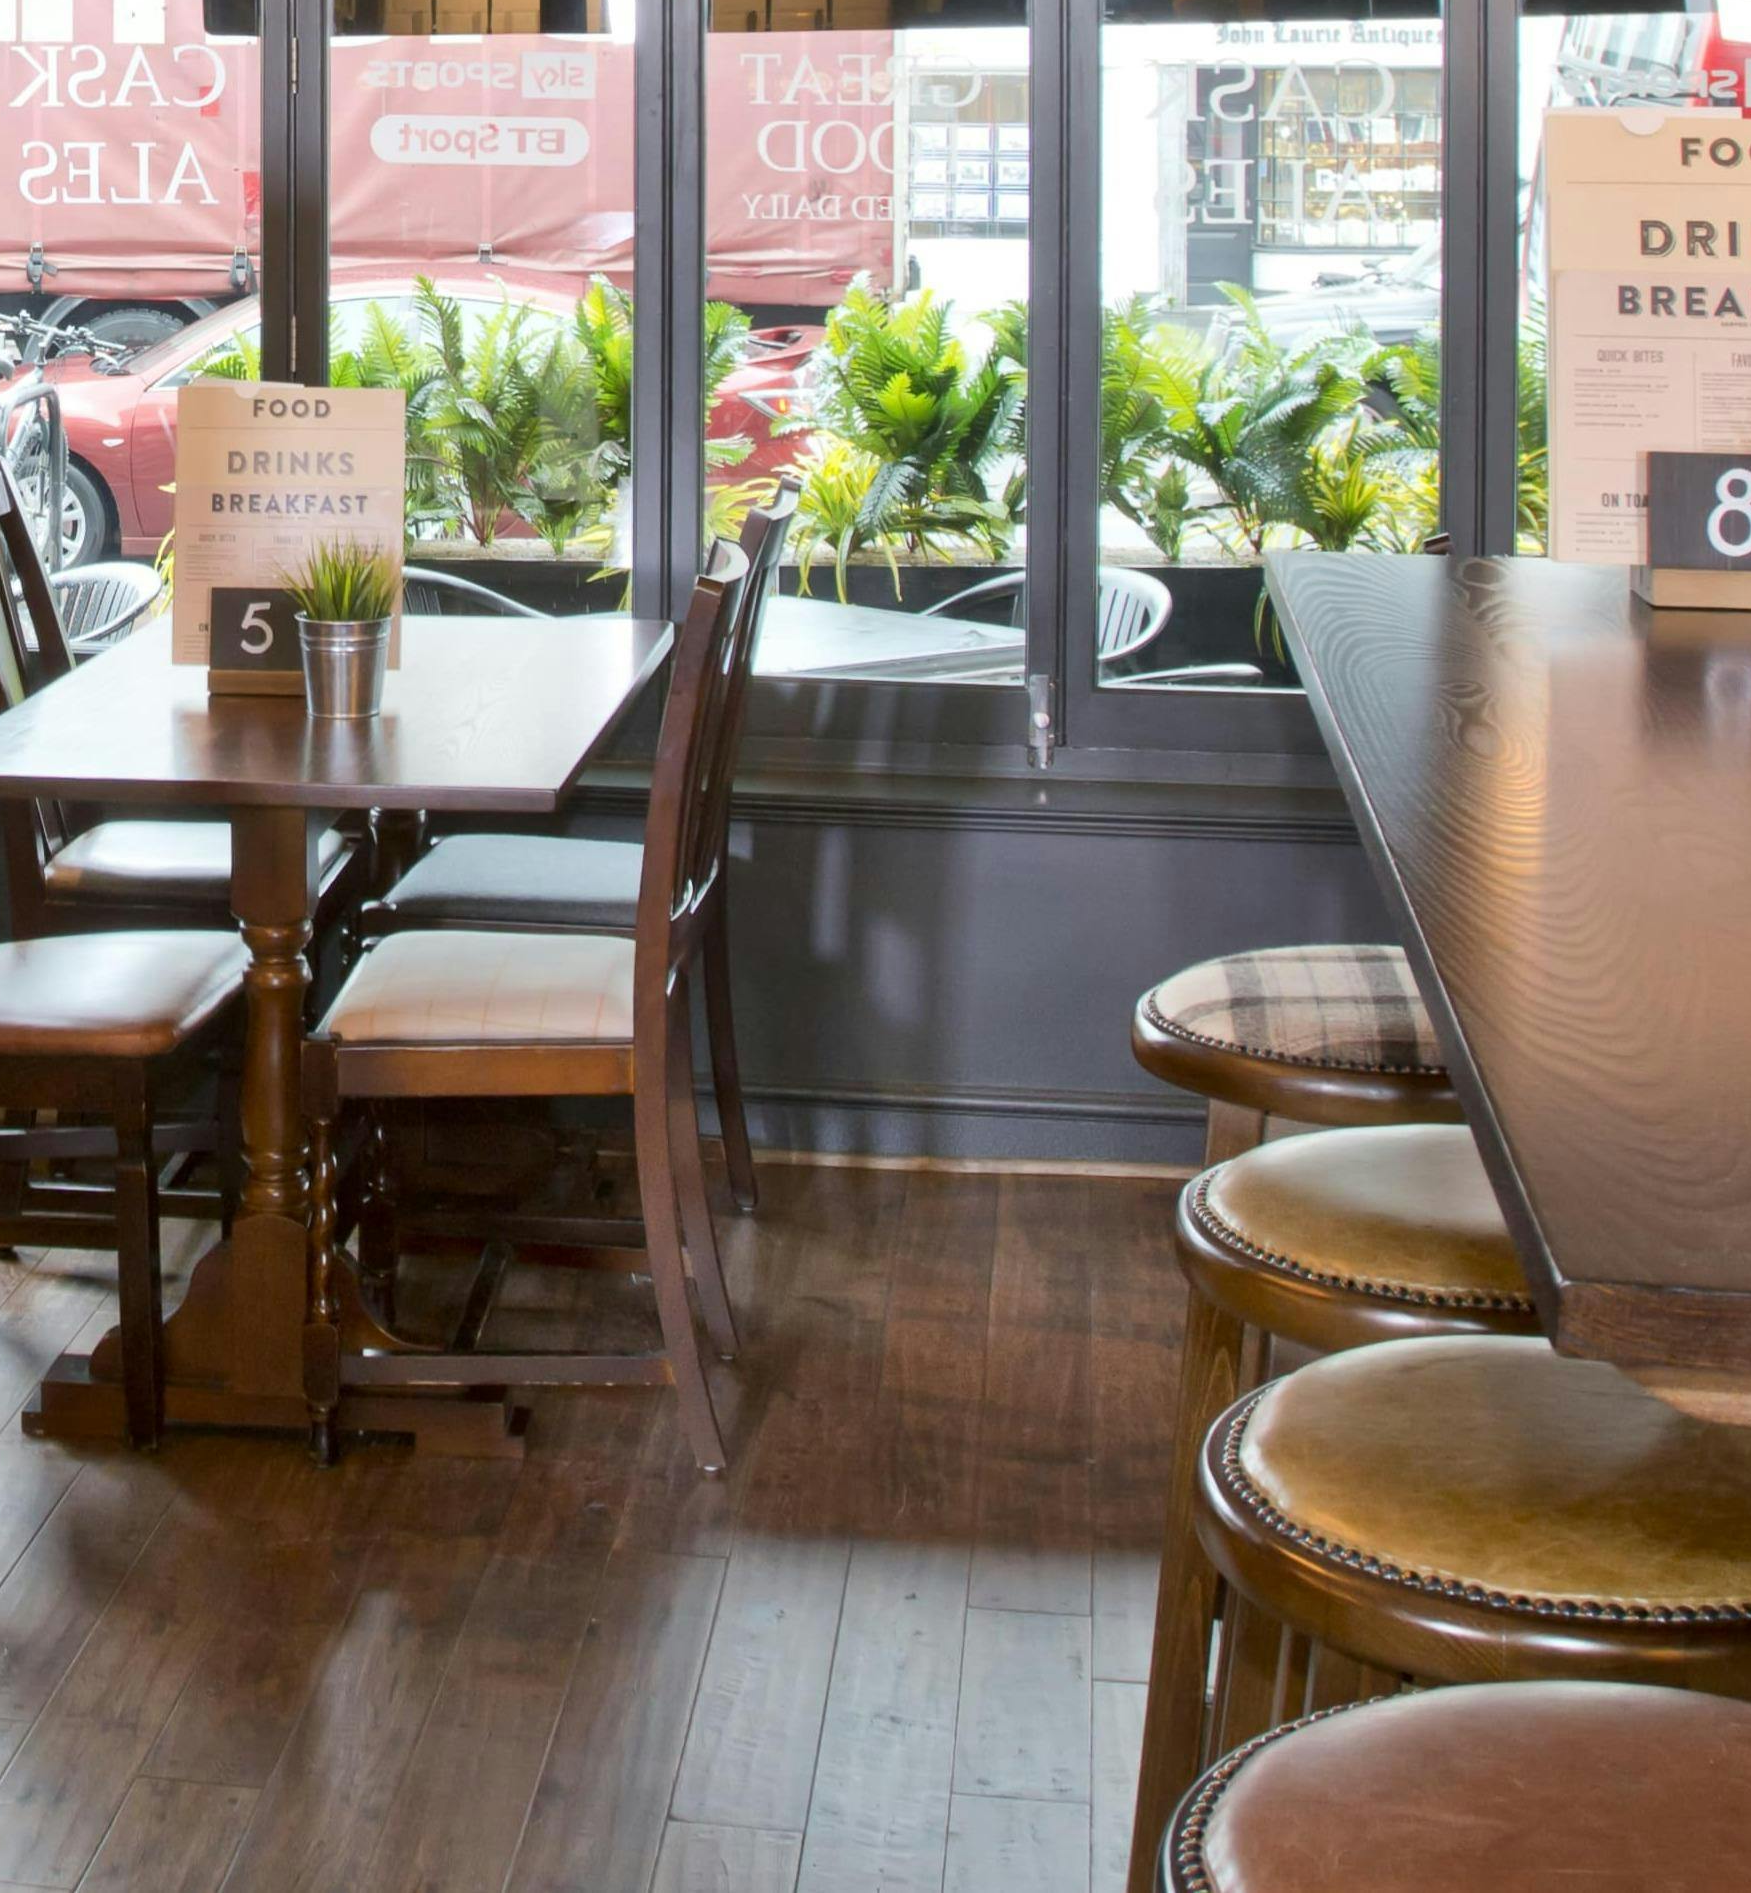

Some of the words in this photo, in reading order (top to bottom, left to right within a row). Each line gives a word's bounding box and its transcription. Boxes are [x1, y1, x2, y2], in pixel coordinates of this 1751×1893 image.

[252, 398, 332, 419] FOOD
[227, 450, 356, 477] DRINKS
[211, 493, 368, 516] BREAKFAST
[1601, 492, 1620, 508] ON
[1625, 493, 1649, 508] TOA
[240, 601, 275, 655] 5
